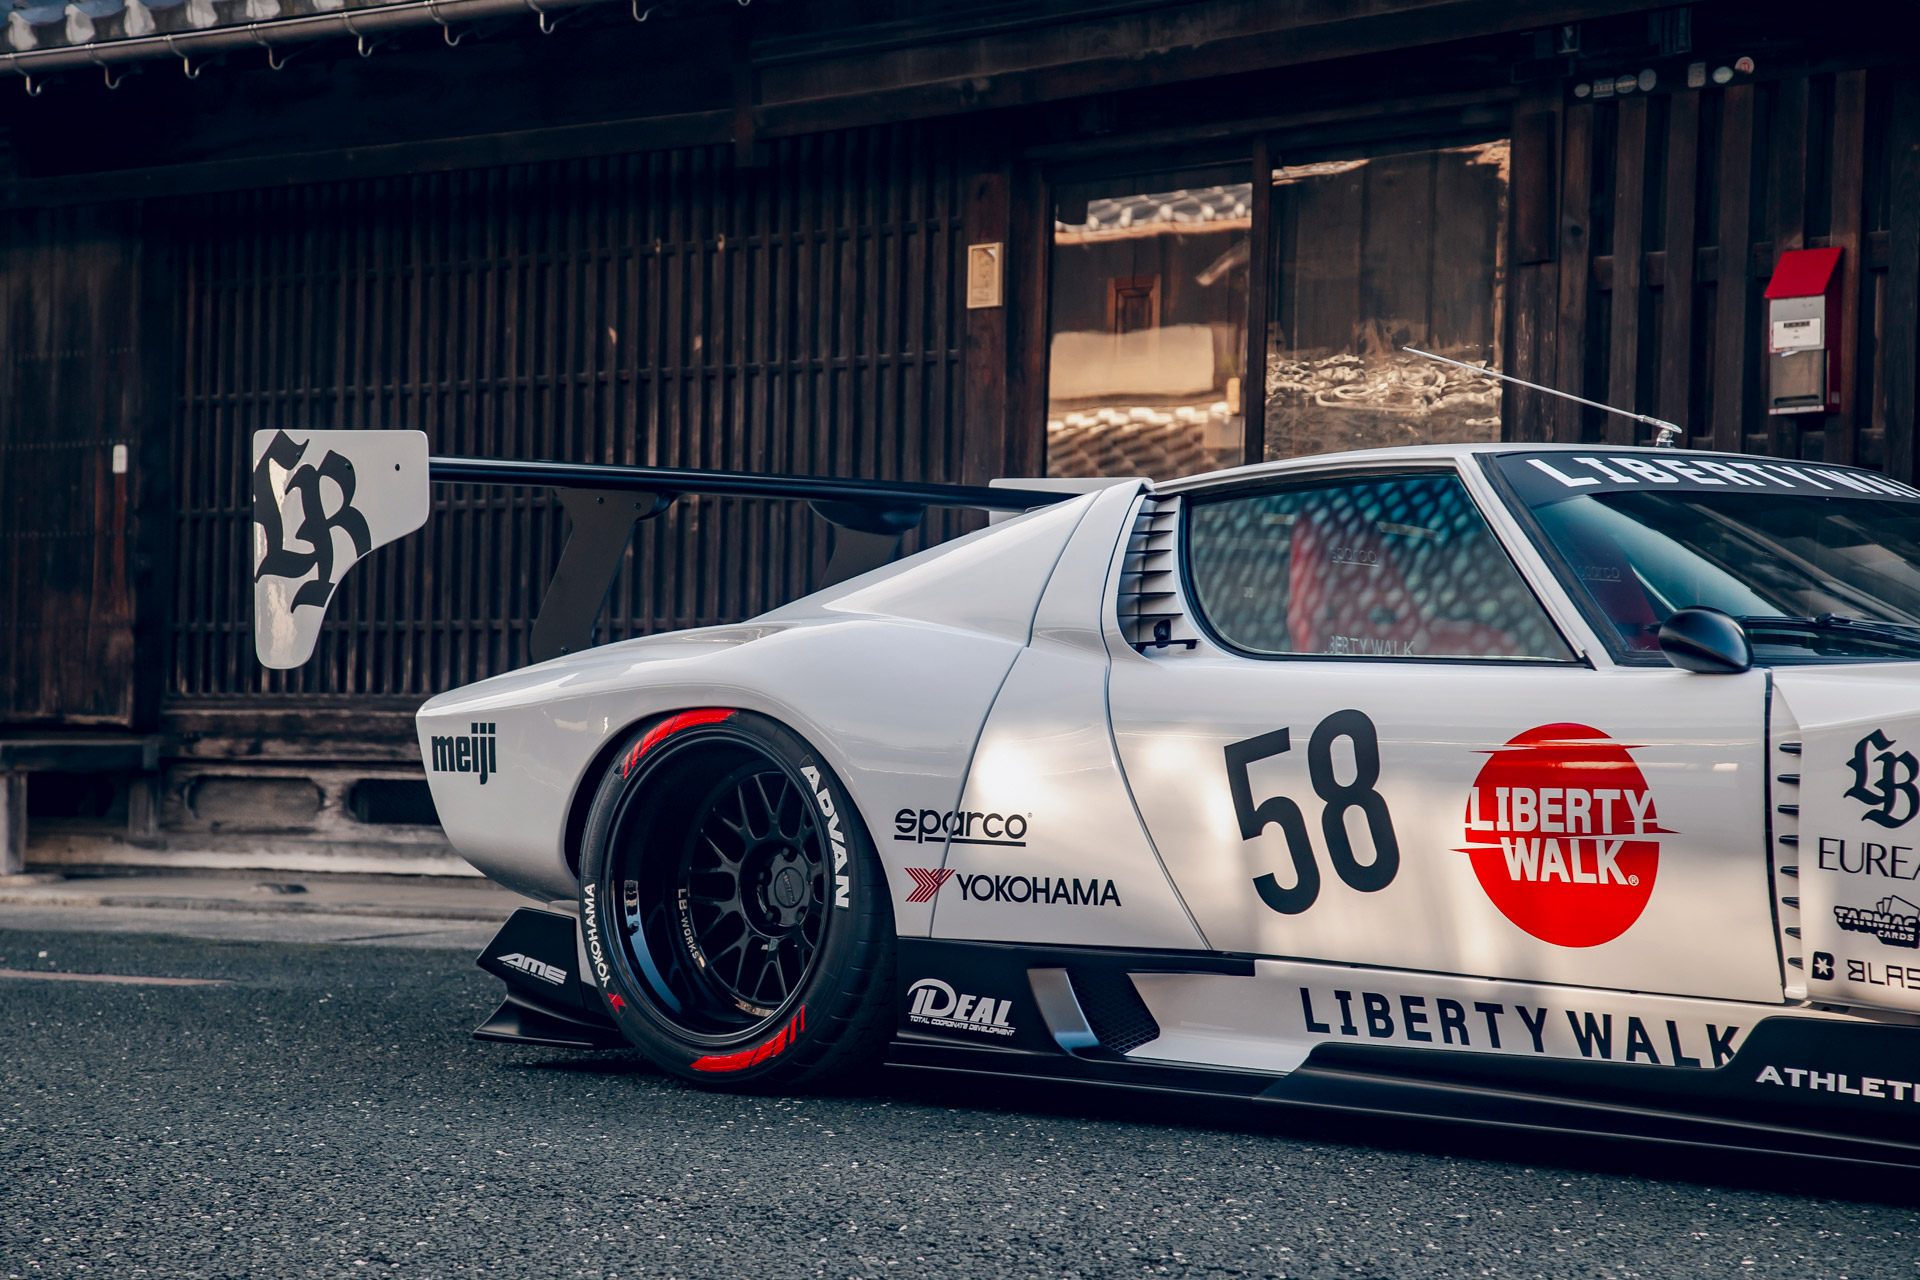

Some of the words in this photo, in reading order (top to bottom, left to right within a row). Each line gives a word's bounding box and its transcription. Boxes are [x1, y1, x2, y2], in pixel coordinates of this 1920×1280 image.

[1526, 457, 1832, 490] LIBERTY
[431, 723, 496, 784] meiji
[800, 765, 850, 908] ADVAN
[1224, 709, 1400, 915] 58
[1467, 786, 1654, 838] LIBERTY
[1819, 837, 1920, 880] EURE
[956, 873, 1121, 906] YOKOHAMA
[584, 883, 611, 988] YOKOHAMA
[678, 888, 701, 959] LB-WORKS
[1834, 906, 1918, 932] TARMAC
[1877, 930, 1915, 941] CARDS
[497, 953, 567, 984] AME
[907, 978, 1012, 1027] IDEAL
[910, 1015, 930, 1025] TOTAL
[1299, 986, 1548, 1053] LIBERTY
[1565, 1010, 1740, 1069] WALK
